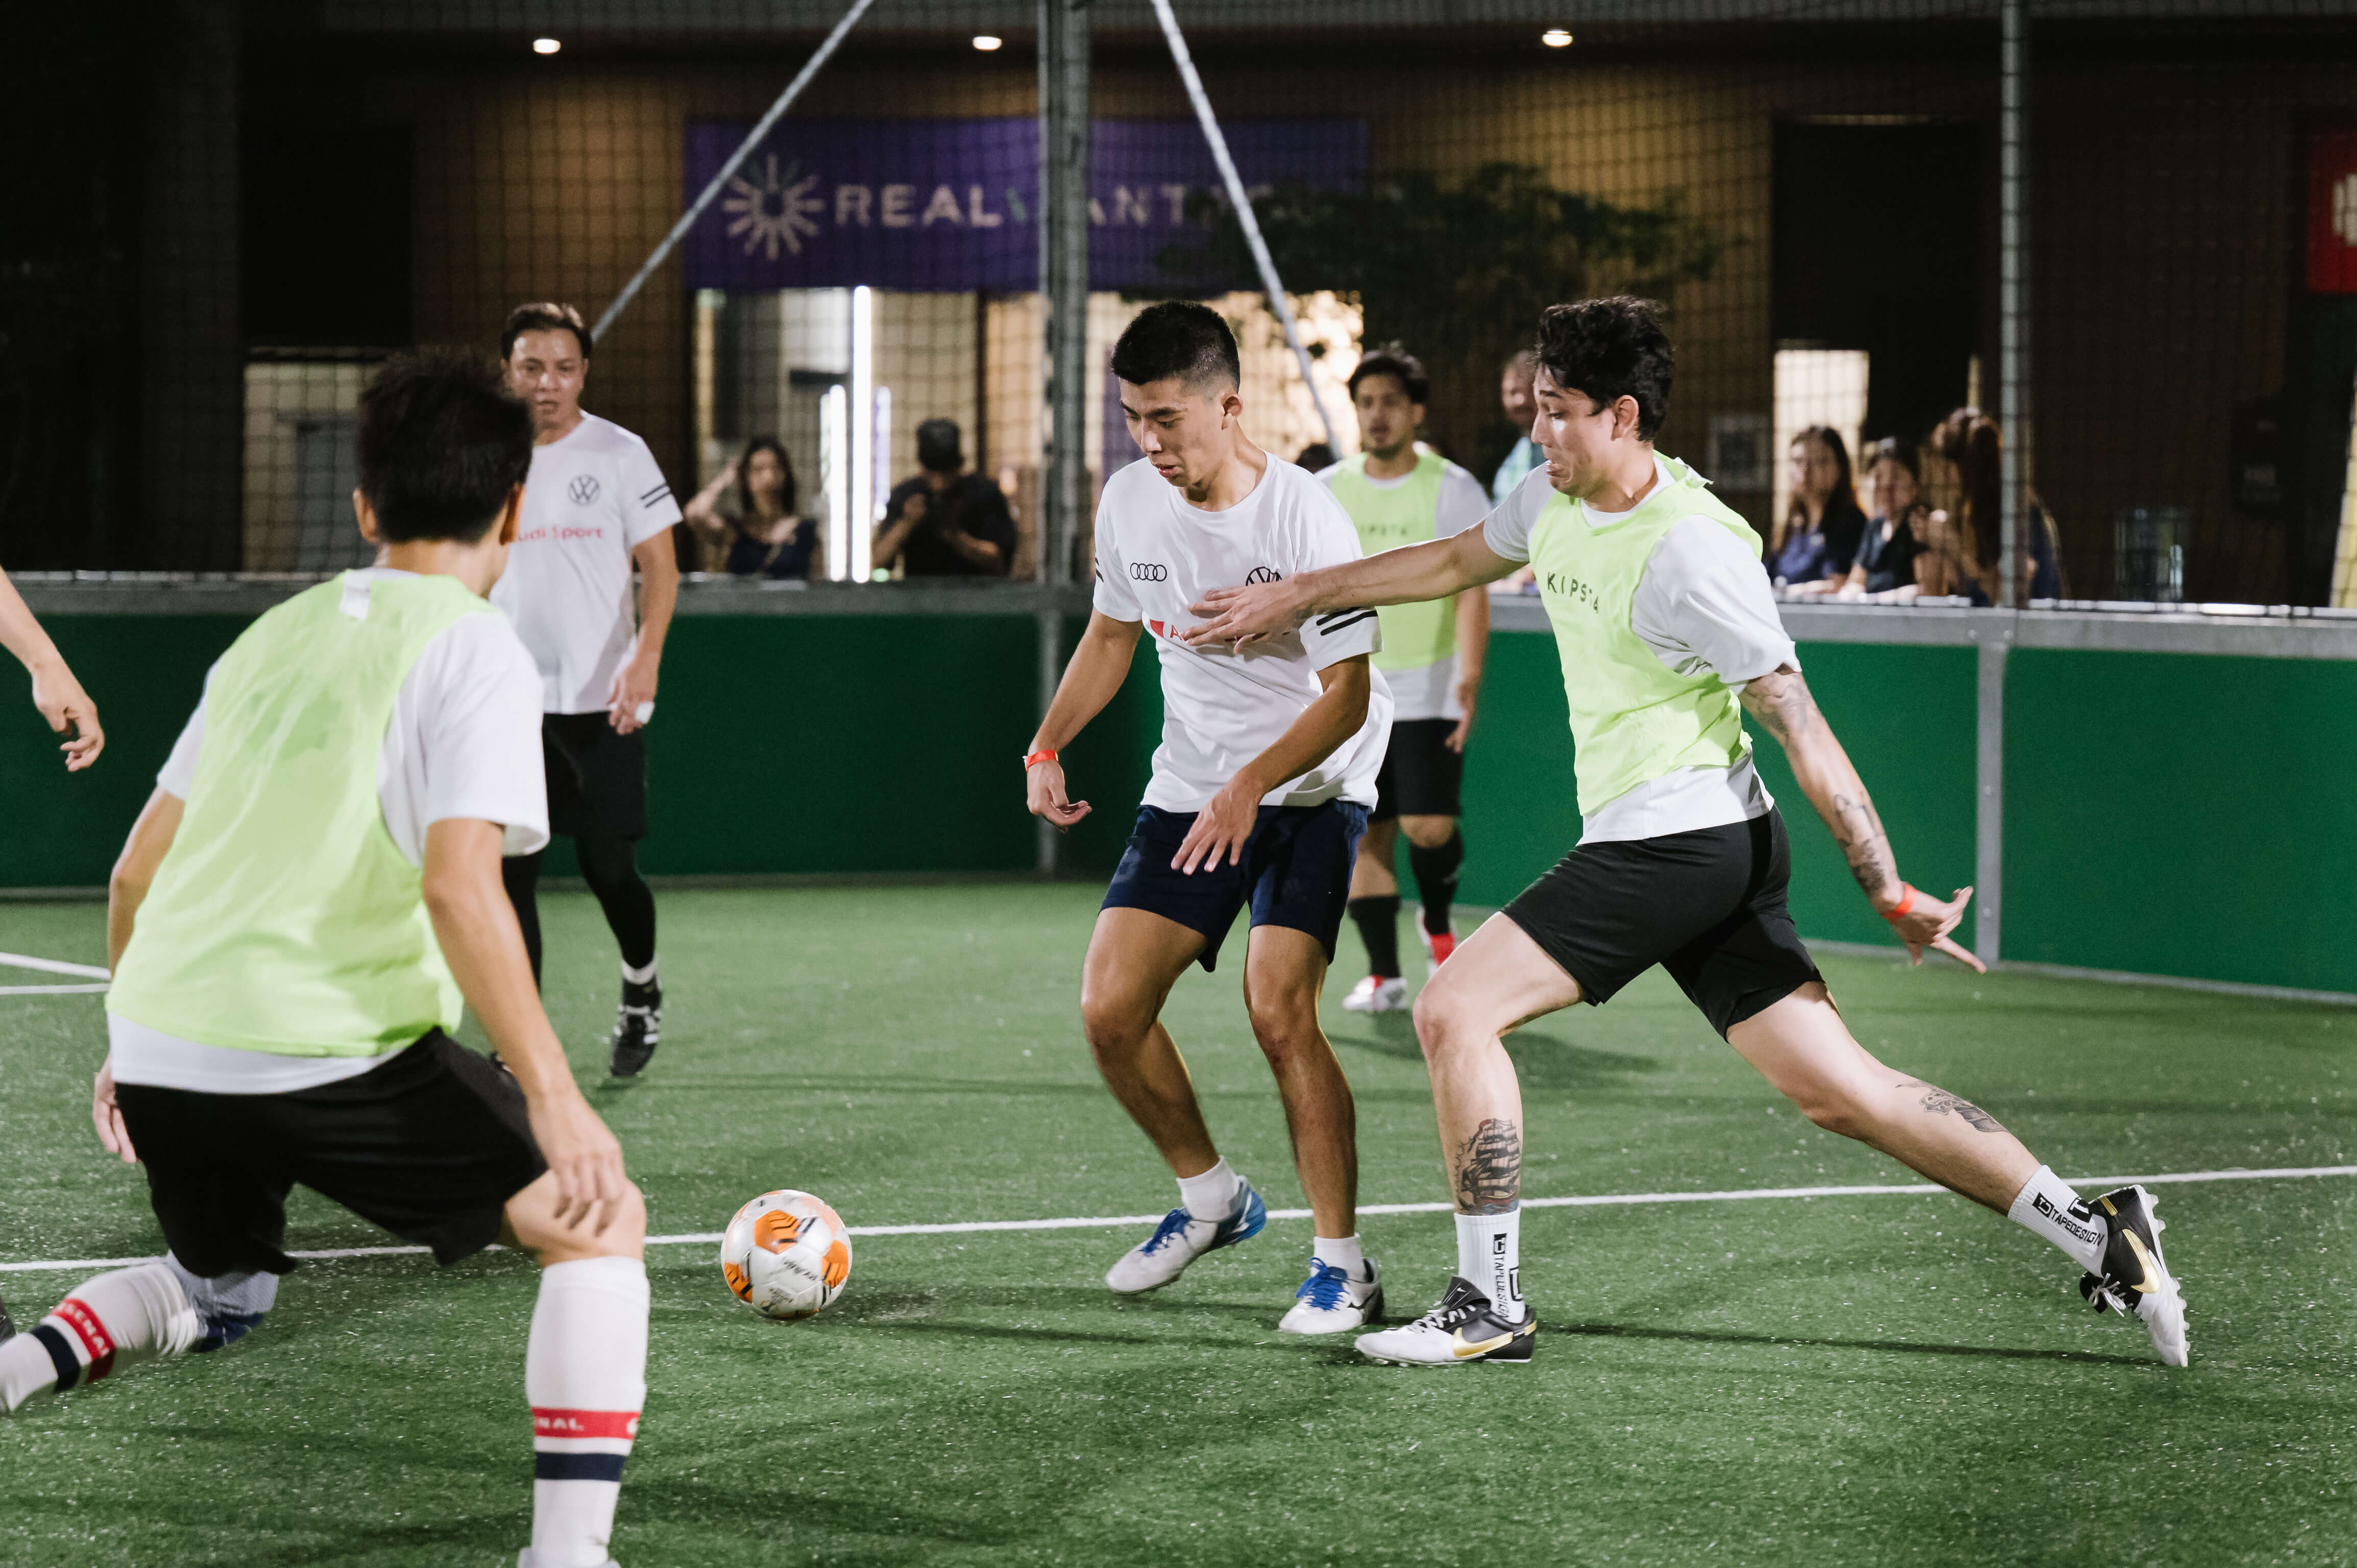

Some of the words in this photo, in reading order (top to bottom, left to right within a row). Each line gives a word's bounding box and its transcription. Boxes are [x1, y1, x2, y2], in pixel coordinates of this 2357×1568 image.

[517, 527, 546, 543] udi
[551, 524, 604, 541] Sport
[2052, 1208, 2105, 1247] TAPEDESIGN
